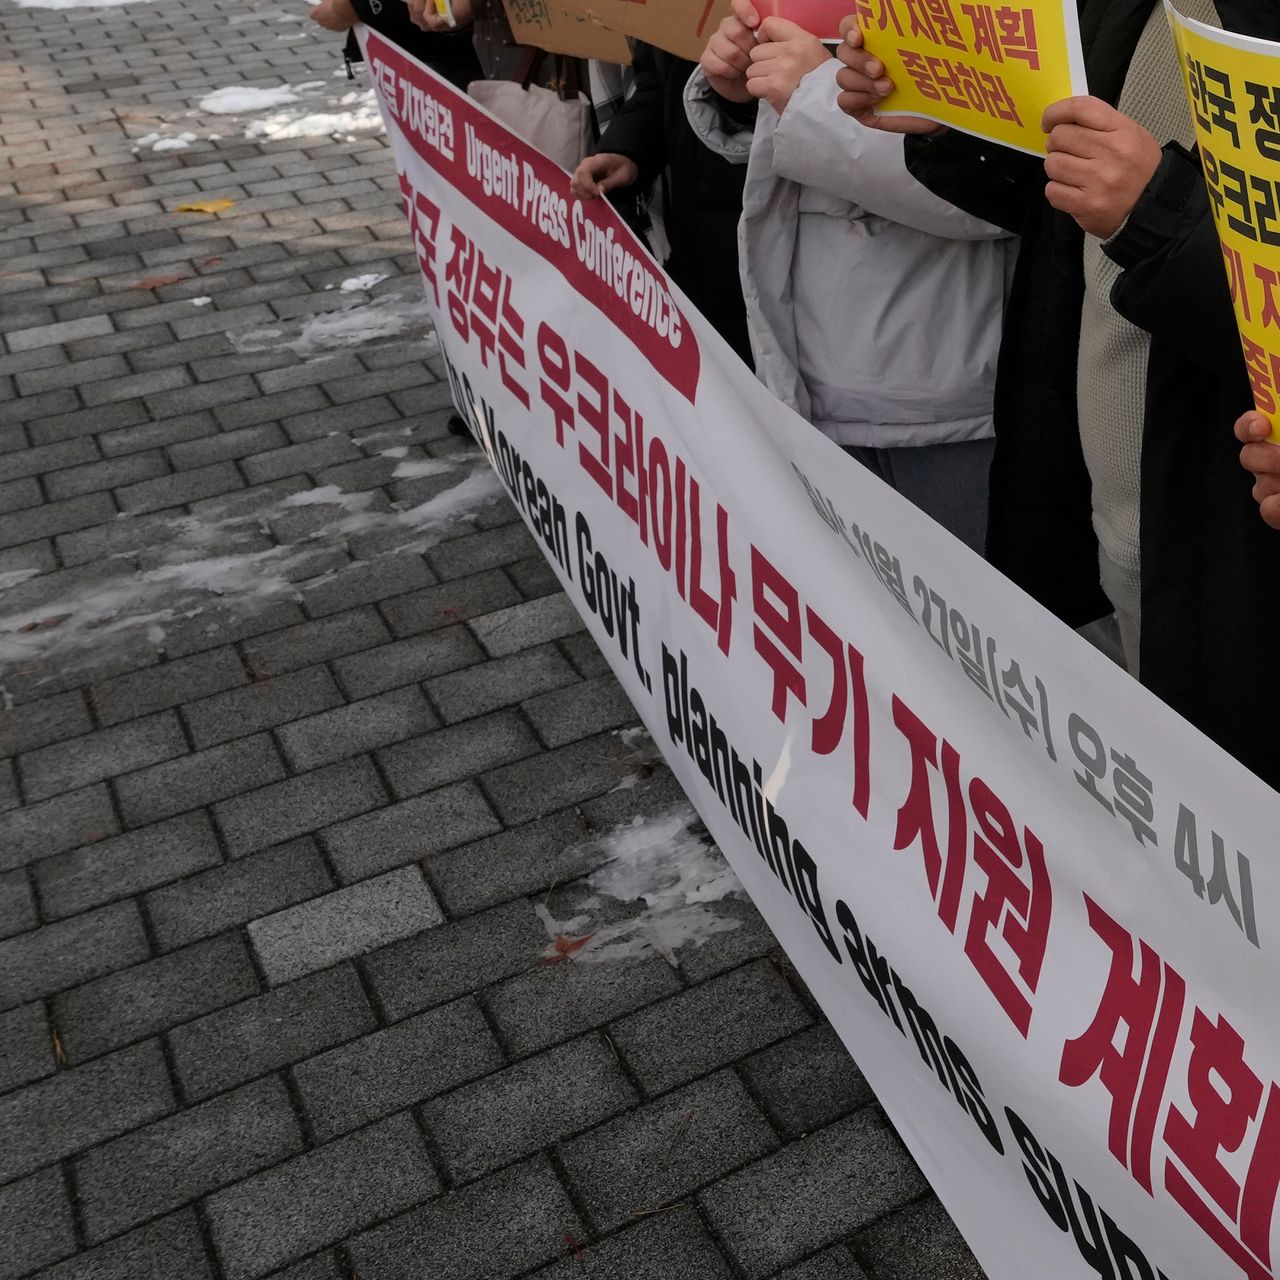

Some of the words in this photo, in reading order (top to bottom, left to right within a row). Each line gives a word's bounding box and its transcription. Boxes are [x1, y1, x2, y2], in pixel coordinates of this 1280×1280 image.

[896, 48, 1025, 128] 중단하라
[960, 2, 1041, 71] 계획
[1185, 52, 1241, 150] 한국
[399, 76, 455, 162] 기자회견
[464, 121, 520, 211] Urgent
[522, 160, 571, 249] Press
[571, 198, 683, 349] Conference
[445, 222, 531, 412] 정부는
[537, 320, 738, 658] 우크라이나
[751, 542, 871, 822] 무기
[892, 691, 1054, 1042] 지원
[911, 573, 1059, 764] 27일(수)
[1066, 711, 1158, 848] 오후
[1173, 801, 1261, 950] 4시
[575, 509, 653, 697] Govt.
[661, 640, 843, 965] planning
[834, 898, 1005, 1156] arms
